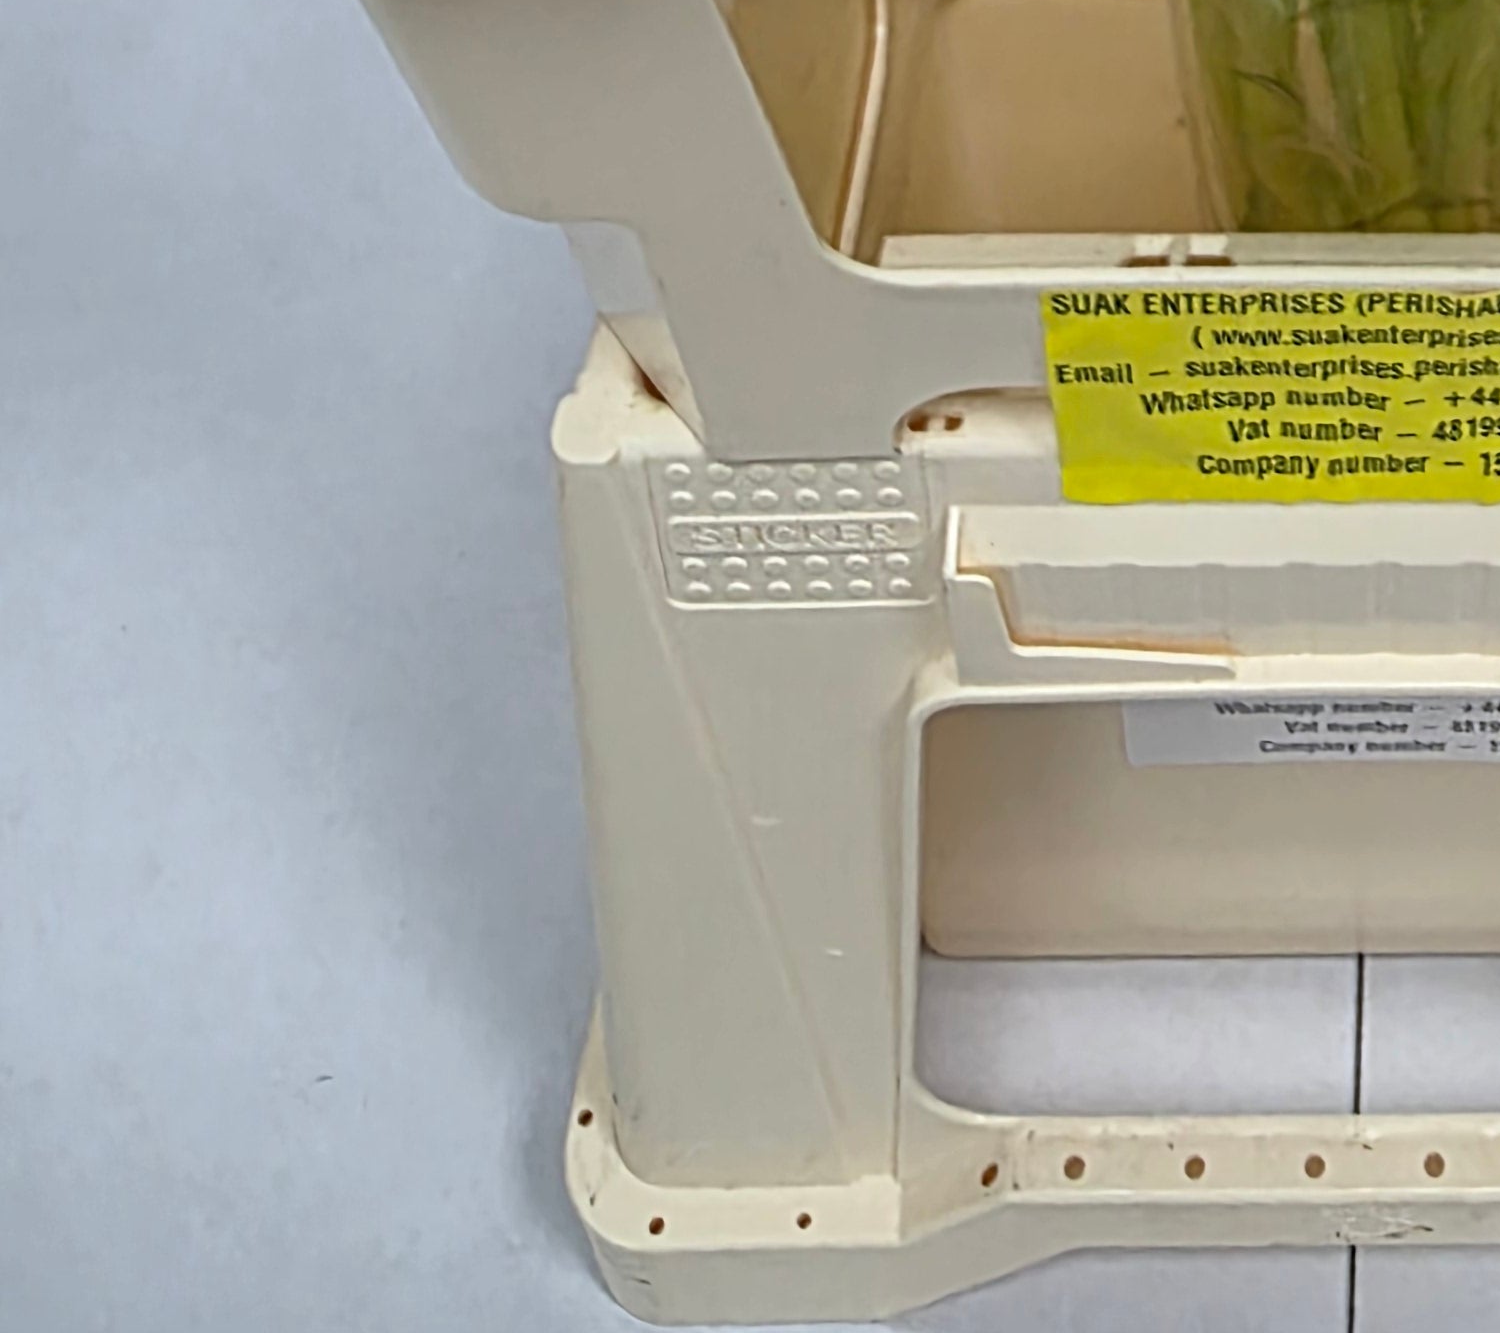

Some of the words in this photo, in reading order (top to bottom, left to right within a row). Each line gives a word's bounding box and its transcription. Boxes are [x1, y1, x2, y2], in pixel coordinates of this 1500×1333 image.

[1051, 292, 1131, 316] SUAK
[1143, 292, 1345, 316] ENTERPRISES
[1054, 362, 1134, 384] Email
[1140, 388, 1276, 416] Whatsapp
[1286, 386, 1392, 412] number
[1227, 417, 1271, 443] Vat
[1279, 417, 1383, 442] number
[1197, 454, 1320, 480] Company
[1326, 452, 1430, 475] number
[1333, 701, 1415, 714] number
[1284, 720, 1319, 734] Vat
[1327, 719, 1409, 733] number
[1259, 739, 1358, 755] Company
[1366, 739, 1447, 752] number
